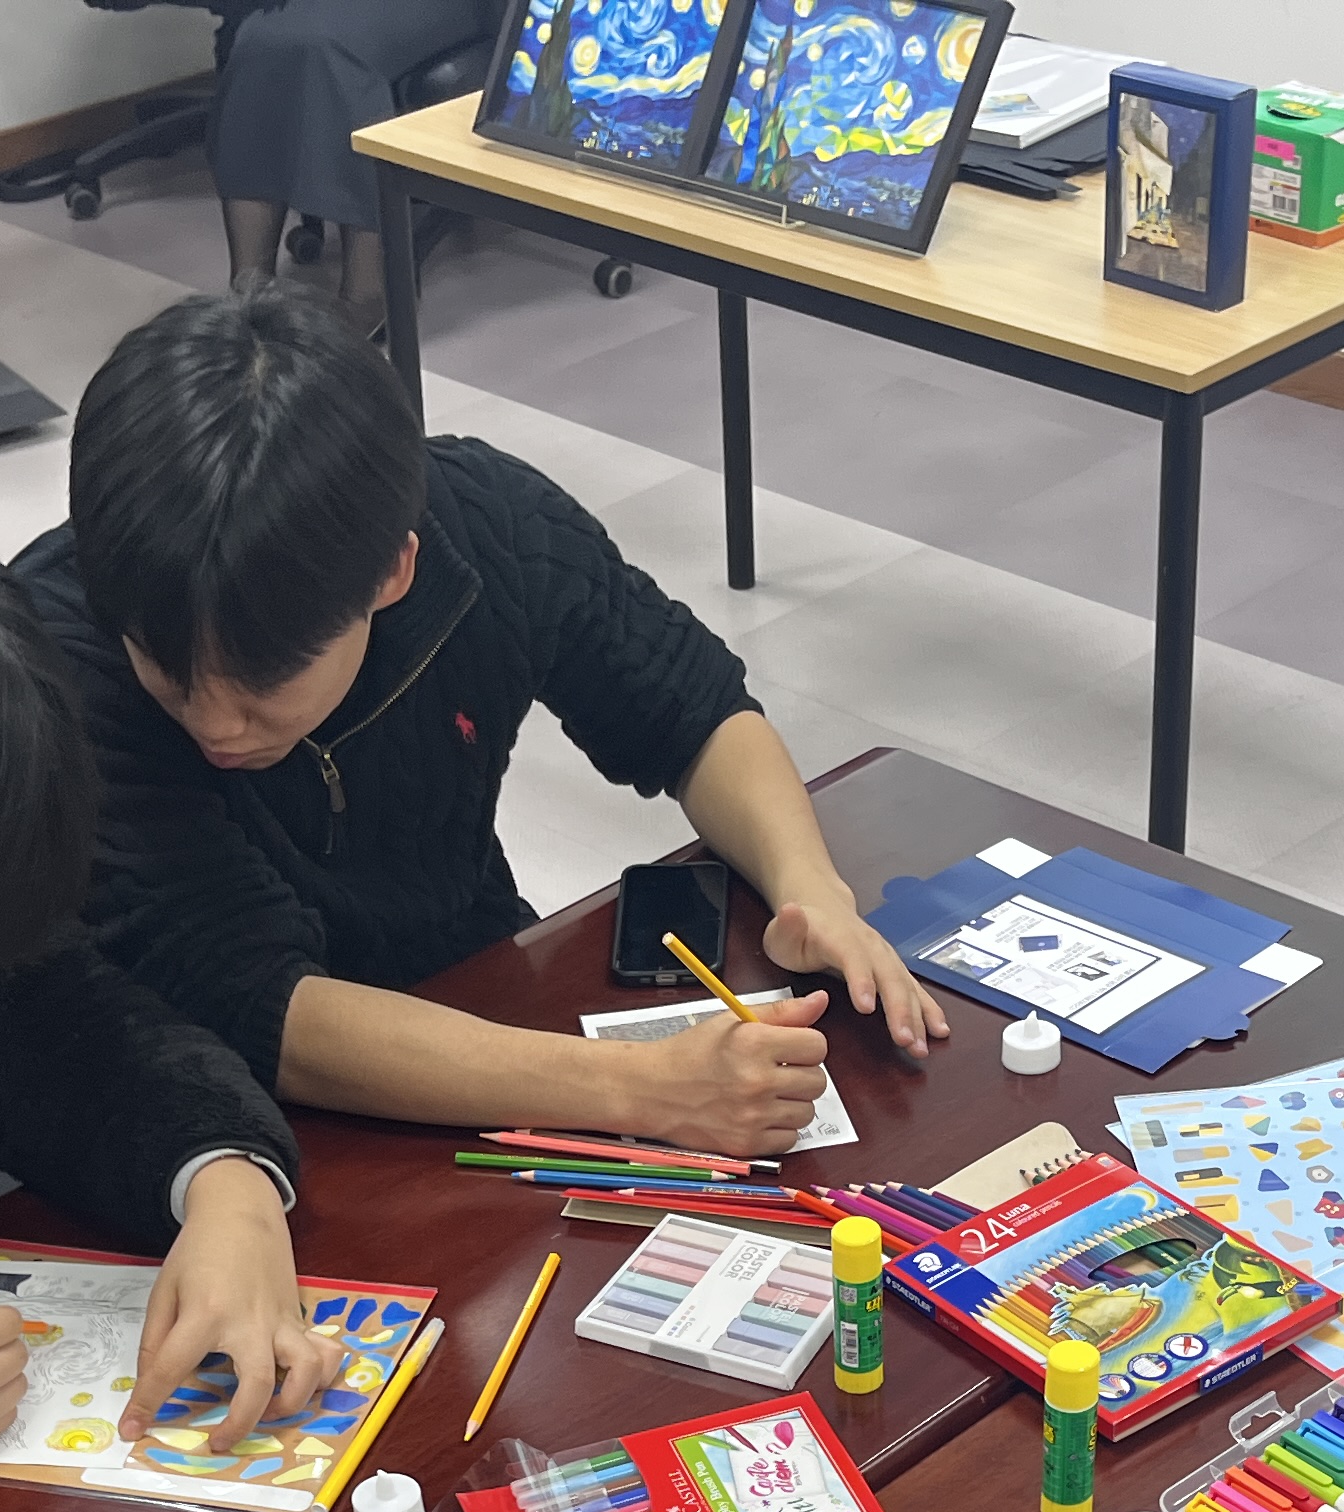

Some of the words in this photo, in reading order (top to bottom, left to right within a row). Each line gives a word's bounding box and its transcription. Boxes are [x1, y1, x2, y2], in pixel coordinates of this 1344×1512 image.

[998, 1203, 1032, 1221] Luna
[959, 1217, 1018, 1255] 24
[725, 1246, 755, 1279] COLOR
[738, 1249, 772, 1281] PASTEL
[891, 1280, 932, 1313] STAEDTLER
[1210, 1353, 1257, 1385] STAEDTLER
[694, 1460, 710, 1478] Pen
[774, 1459, 797, 1493] diem
[704, 1480, 723, 1502] Brush
